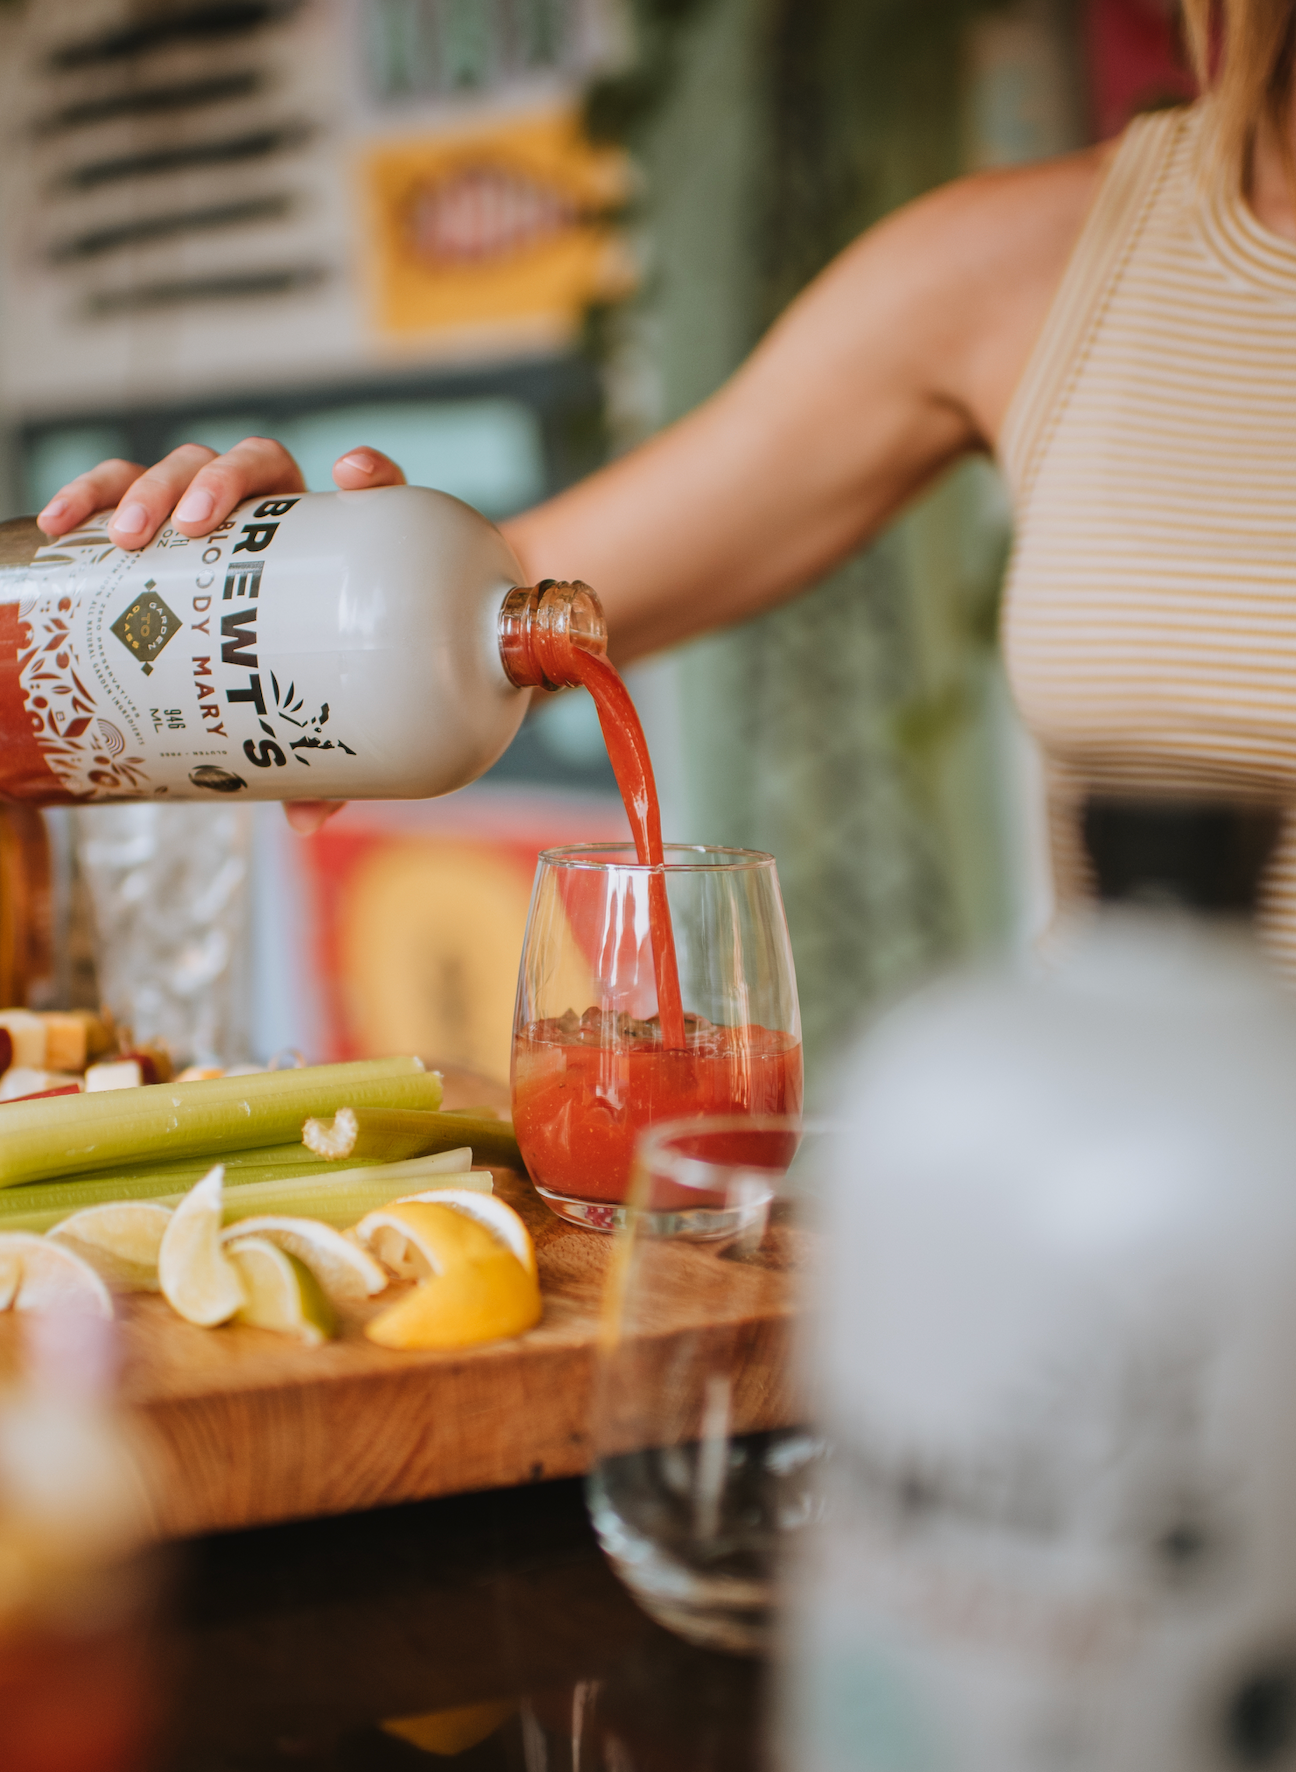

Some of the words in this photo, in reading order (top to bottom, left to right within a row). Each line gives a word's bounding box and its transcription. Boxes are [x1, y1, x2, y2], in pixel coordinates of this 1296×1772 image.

[157, 529, 173, 548] OZ
[112, 554, 130, 574] FROM
[191, 521, 236, 636] BLOODY
[95, 576, 111, 596] 100%
[106, 574, 124, 598] WITH
[88, 600, 97, 616] ALL
[96, 603, 106, 631] ZERO
[124, 605, 140, 649] GLASS
[140, 612, 151, 637] TO
[148, 602, 168, 650] GARDEN
[221, 498, 301, 767] BREWT'S
[86, 620, 95, 660] NATURAL
[93, 663, 112, 695] GARDEN
[97, 637, 140, 718] PRESERVATIVES
[191, 656, 228, 738] MARY
[111, 696, 145, 745] INGREDIENTS
[149, 708, 163, 733] ML
[163, 709, 187, 729] 946
